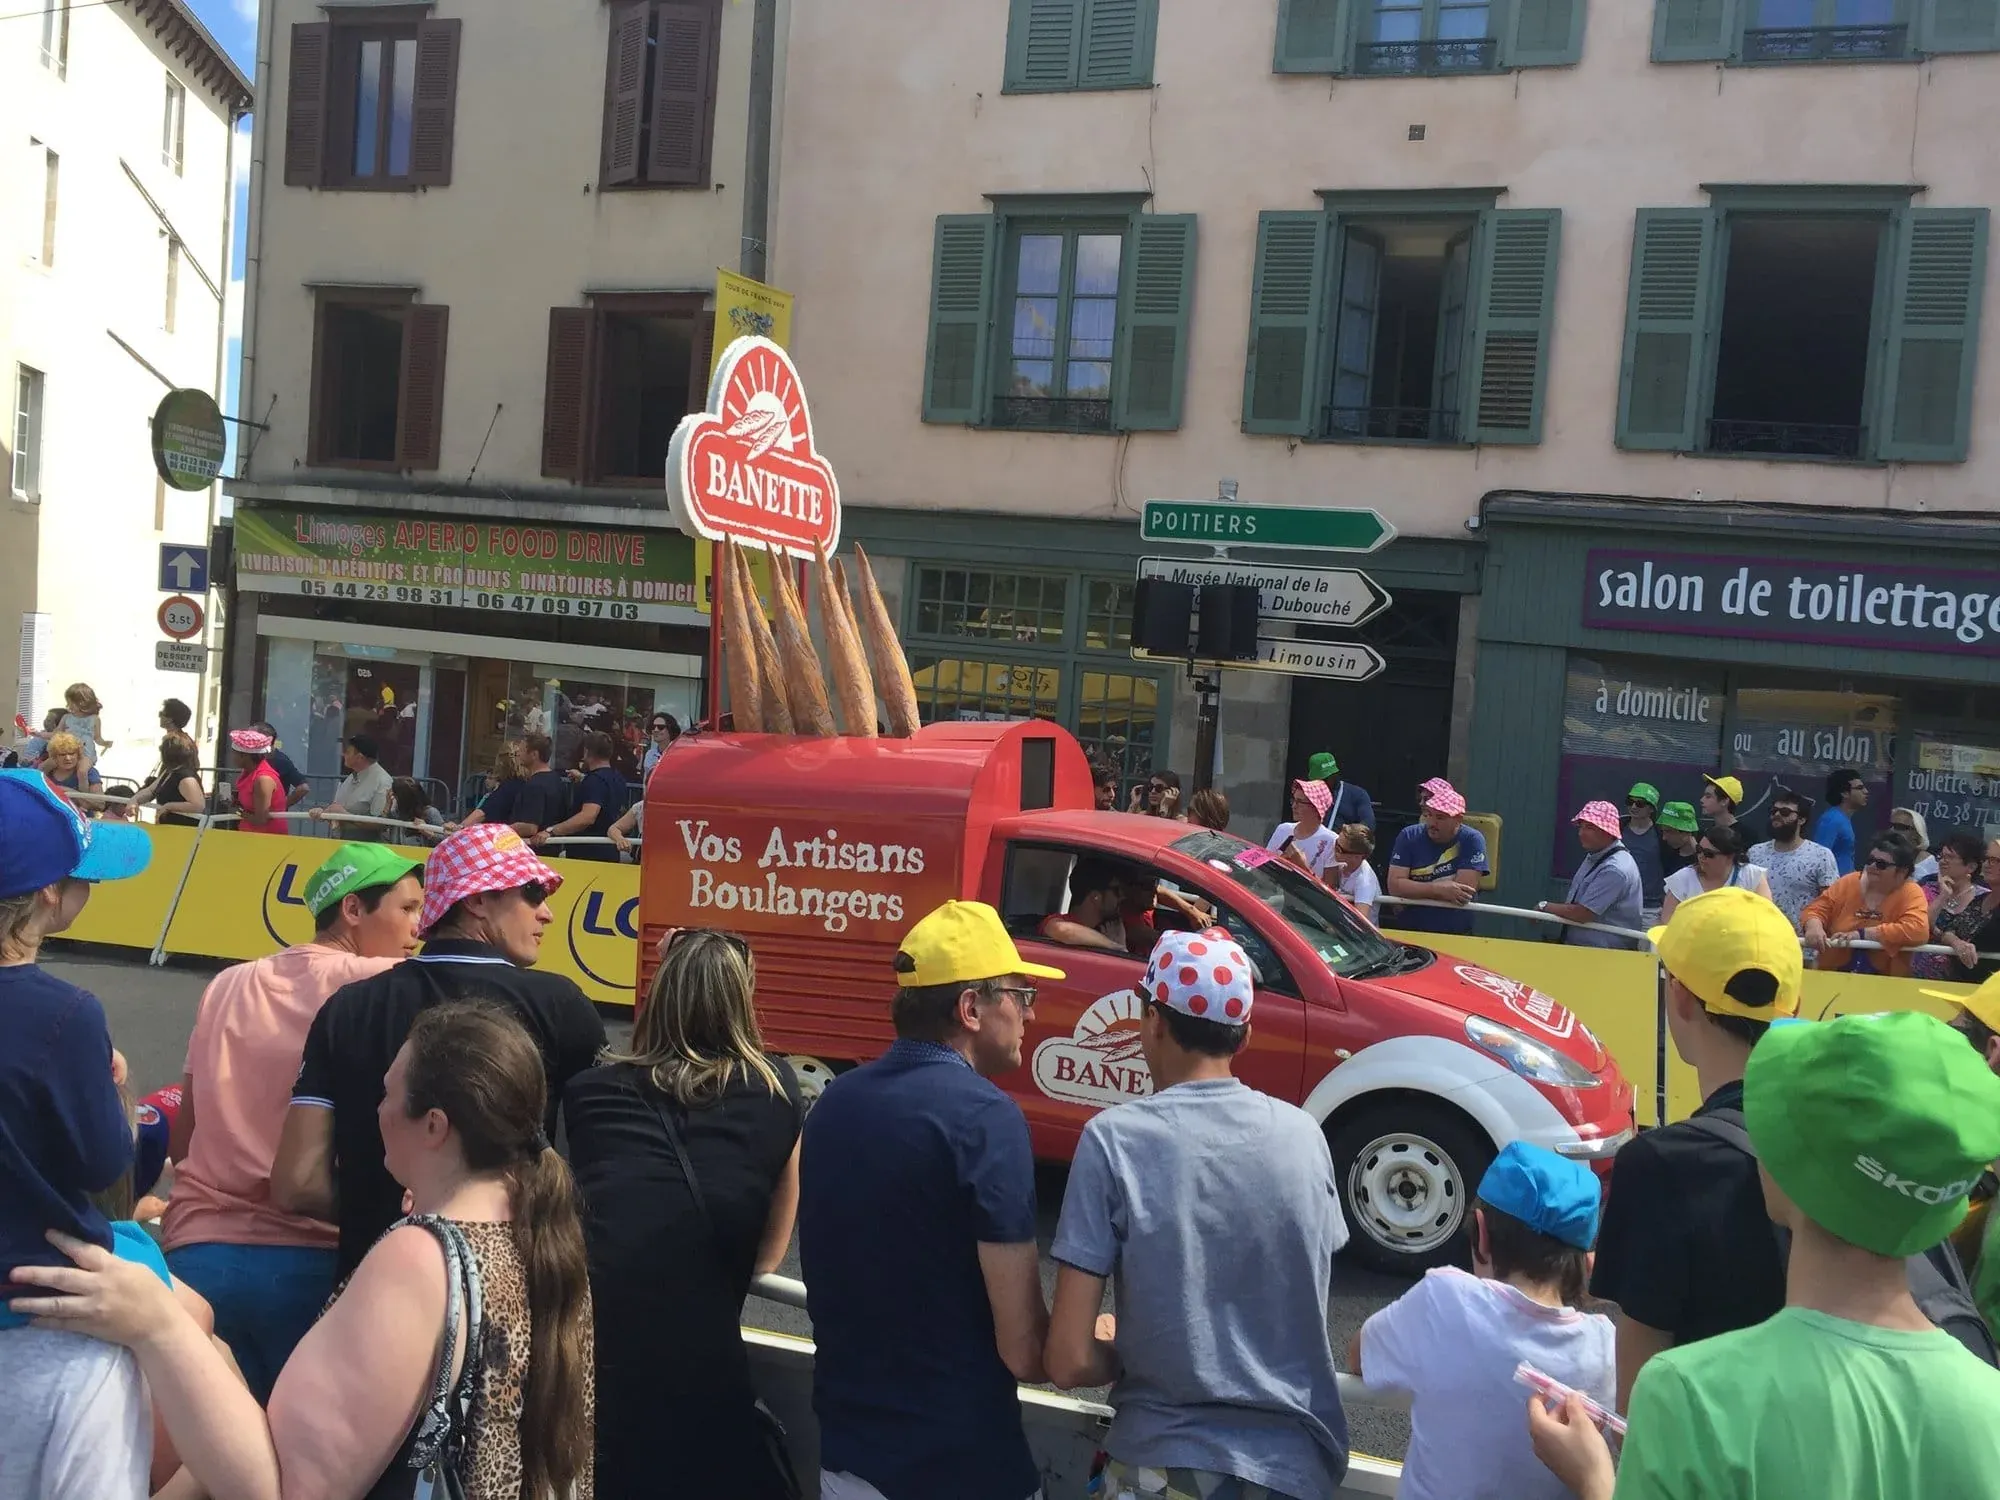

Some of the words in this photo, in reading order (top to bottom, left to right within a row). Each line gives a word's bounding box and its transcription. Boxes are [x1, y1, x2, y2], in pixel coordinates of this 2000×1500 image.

[706, 451, 825, 525] BANETTE
[1152, 512, 1257, 534] POITIERS
[296, 514, 386, 556] Limoges
[394, 520, 479, 555] APERO
[487, 526, 558, 560] FOOD
[566, 531, 646, 567] DRIVE
[241, 553, 313, 574] LIVRAISON
[412, 566, 429, 583] ET
[434, 566, 511, 589] PRODUITS
[520, 572, 613, 597] DINATOIRES
[617, 576, 628, 598] À
[1171, 568, 1221, 585] Musée
[1225, 572, 1289, 591] National
[1292, 576, 1310, 593] de
[1315, 577, 1328, 594] la
[1599, 561, 1704, 612] salon
[1721, 567, 1772, 617] de
[301, 580, 326, 596] 05
[332, 581, 357, 598] 44
[364, 583, 389, 600] 23
[396, 587, 422, 603] 98
[430, 589, 453, 605] 31
[477, 592, 504, 609] 06
[511, 596, 534, 611] 47
[542, 598, 570, 614] 09
[577, 601, 603, 617] 97
[610, 603, 639, 620] 03
[1272, 595, 1351, 616] Dubouché
[157, 651, 204, 663] DESSERTE
[170, 644, 192, 653] SAUF
[1269, 647, 1356, 671] Limousin
[163, 660, 197, 670] LOCALE
[1595, 680, 1608, 714] à
[1616, 681, 1710, 723] domicile
[1733, 732, 1752, 752] ou
[1777, 728, 1806, 757] au
[1814, 727, 1870, 763] salon
[1908, 769, 1967, 795] toilette
[1933, 800, 1950, 819] 82
[1952, 802, 1971, 825] 38
[1974, 807, 1990, 828] 77
[675, 820, 742, 863] Vos
[758, 826, 925, 874] Artisans
[689, 869, 904, 932] Boulangers
